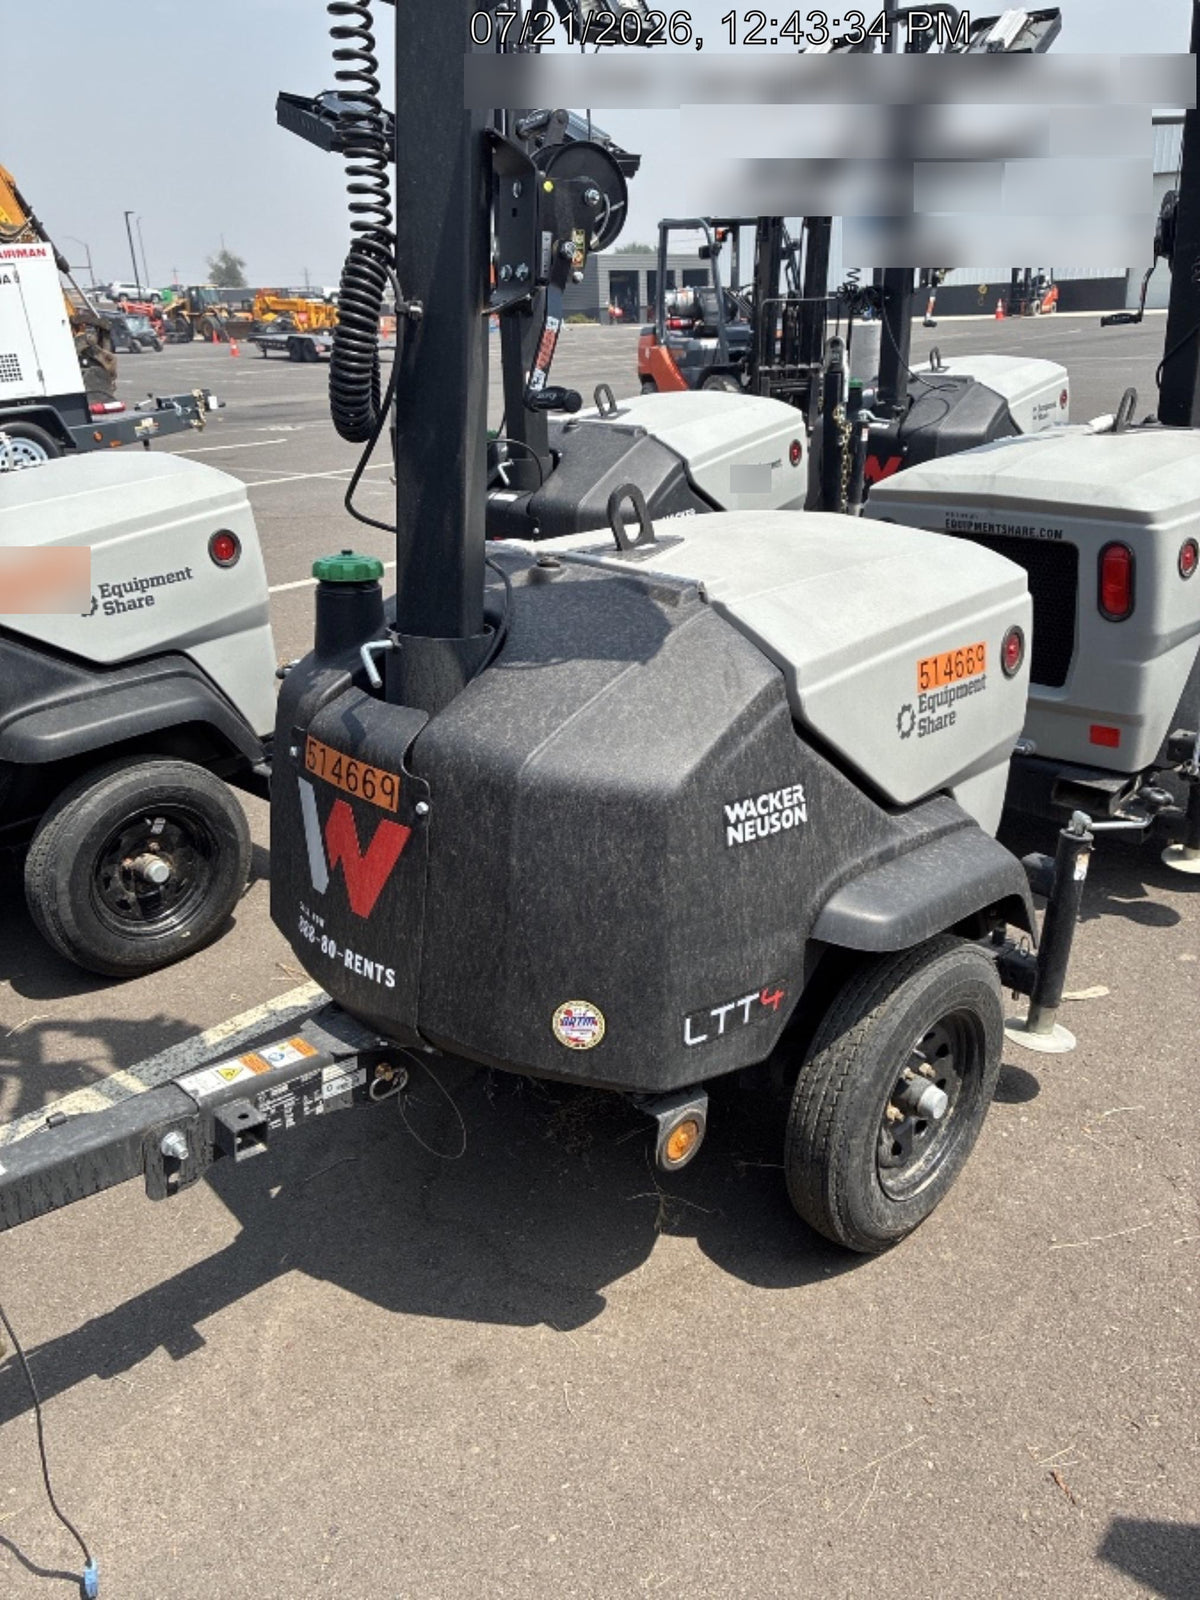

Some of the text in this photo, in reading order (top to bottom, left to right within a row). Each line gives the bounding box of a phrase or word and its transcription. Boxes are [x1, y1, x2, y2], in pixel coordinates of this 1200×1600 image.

[99, 567, 193, 600] Equipment
[103, 595, 155, 616] Share
[920, 644, 985, 690] 514669
[918, 674, 986, 714] Equipment
[917, 711, 956, 738] Share
[306, 740, 397, 810] 514669
[724, 784, 806, 824] WACKER
[726, 803, 808, 847] NEUSON
